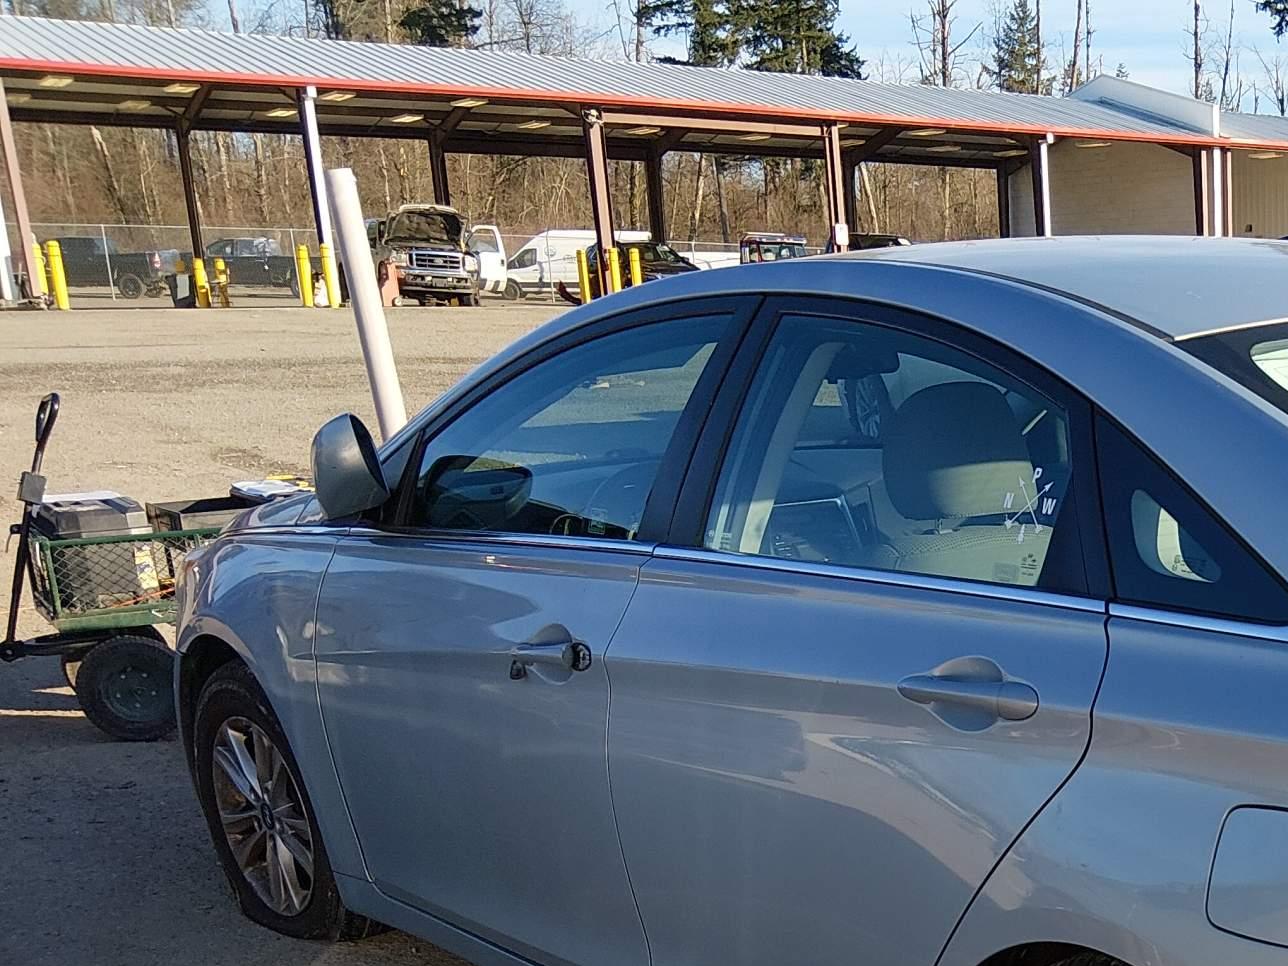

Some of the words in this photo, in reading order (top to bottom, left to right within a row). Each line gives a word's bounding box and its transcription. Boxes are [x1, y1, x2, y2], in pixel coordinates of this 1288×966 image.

[1031, 467, 1043, 484] P
[1003, 492, 1015, 509] N
[1041, 497, 1057, 515] W
